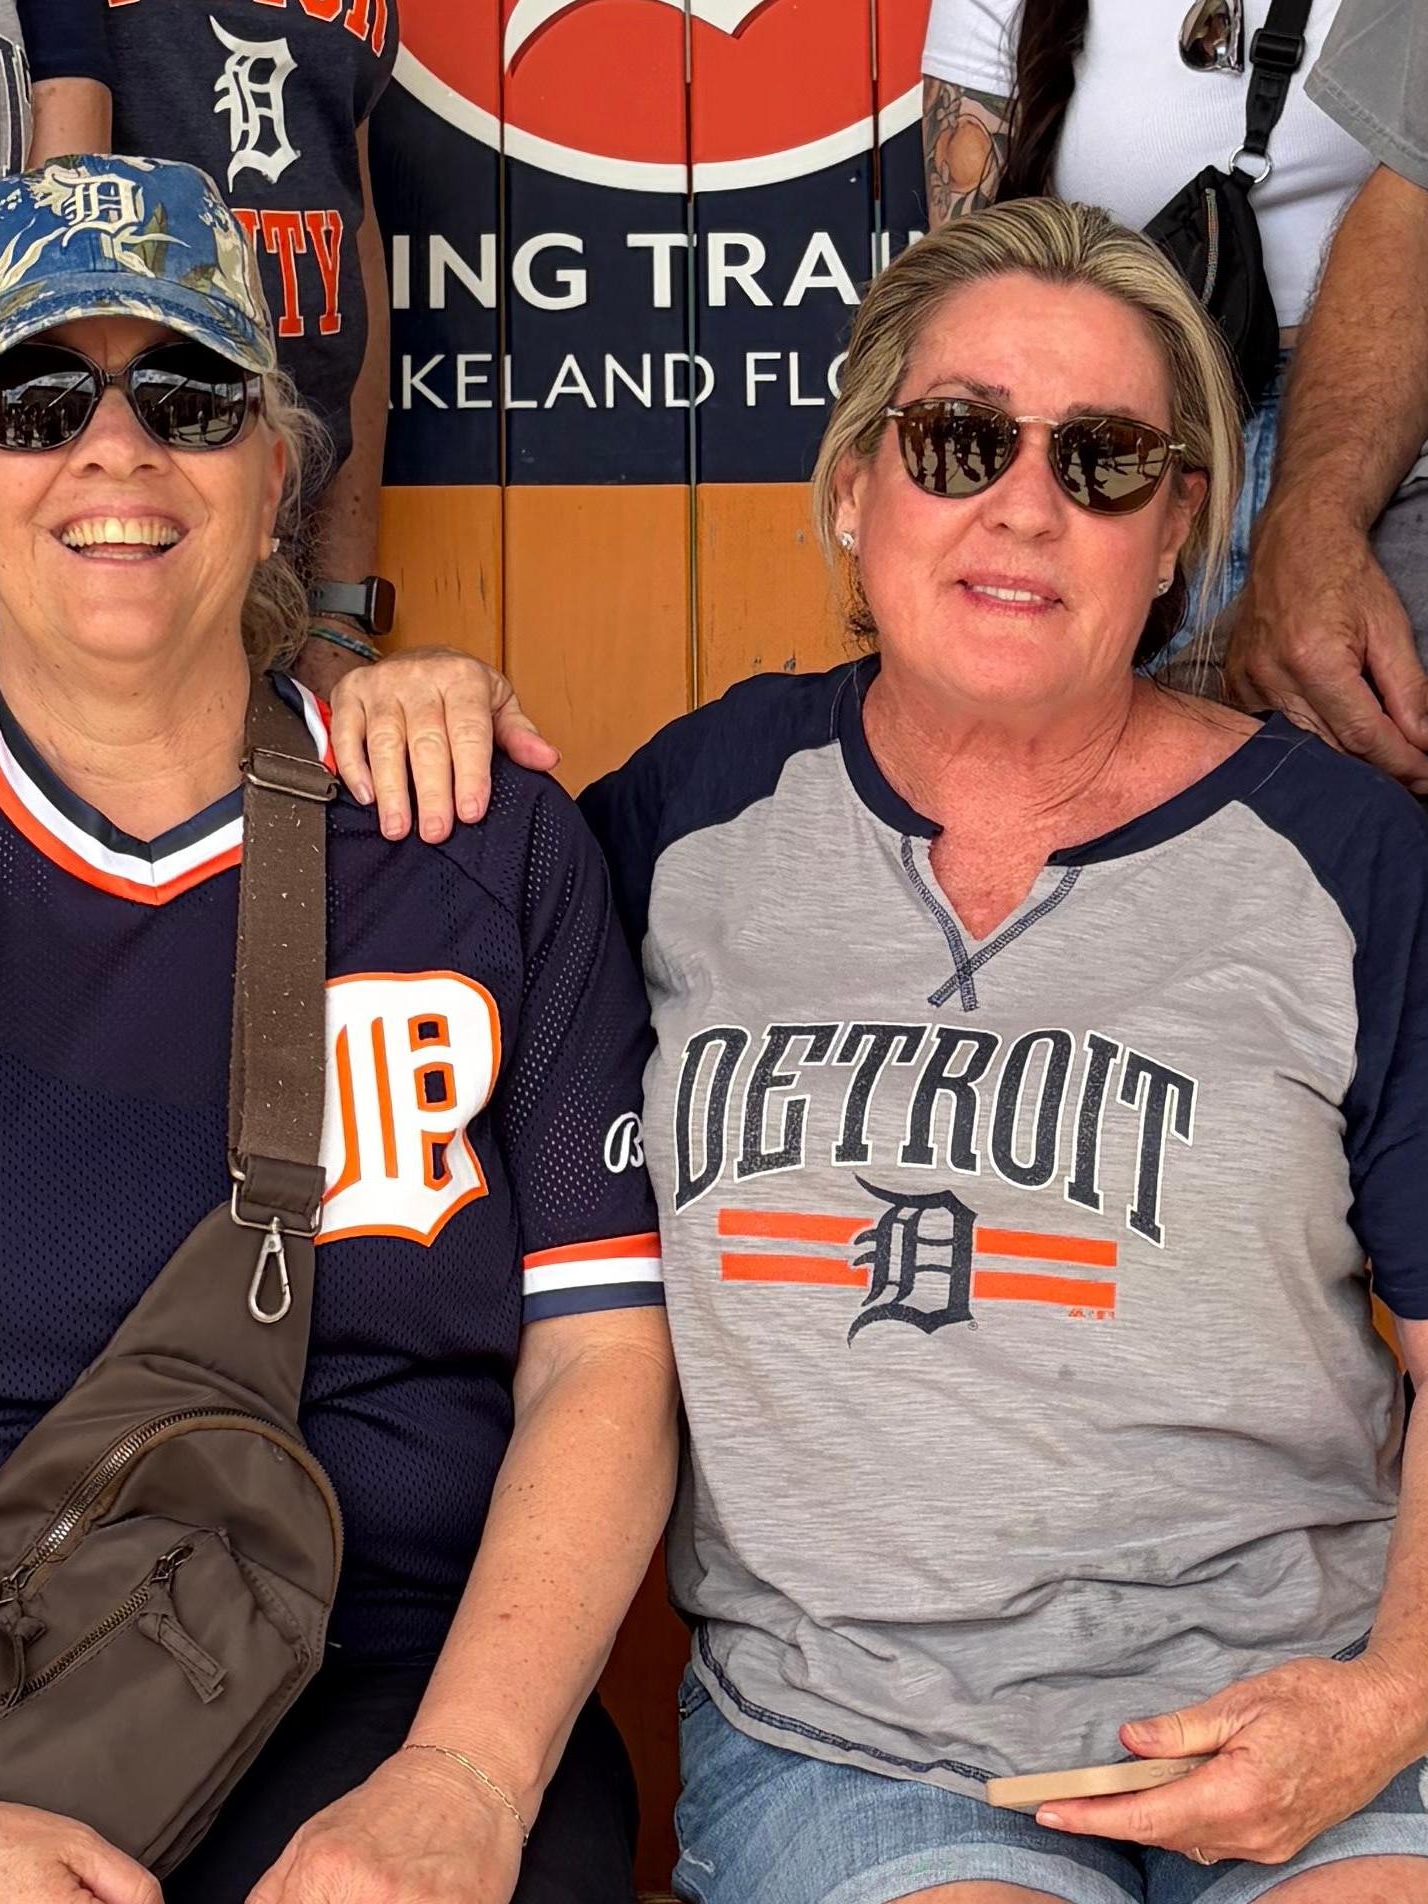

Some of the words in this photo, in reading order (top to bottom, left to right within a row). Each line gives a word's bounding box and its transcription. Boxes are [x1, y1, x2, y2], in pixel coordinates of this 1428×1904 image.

[208, 15, 302, 193] D
[232, 208, 344, 338] TY
[392, 231, 587, 311] ING
[626, 231, 925, 309] TRAI
[388, 352, 716, 411] KELAND
[674, 1020, 1199, 1249] DETROIT
[846, 1171, 979, 1350] D
